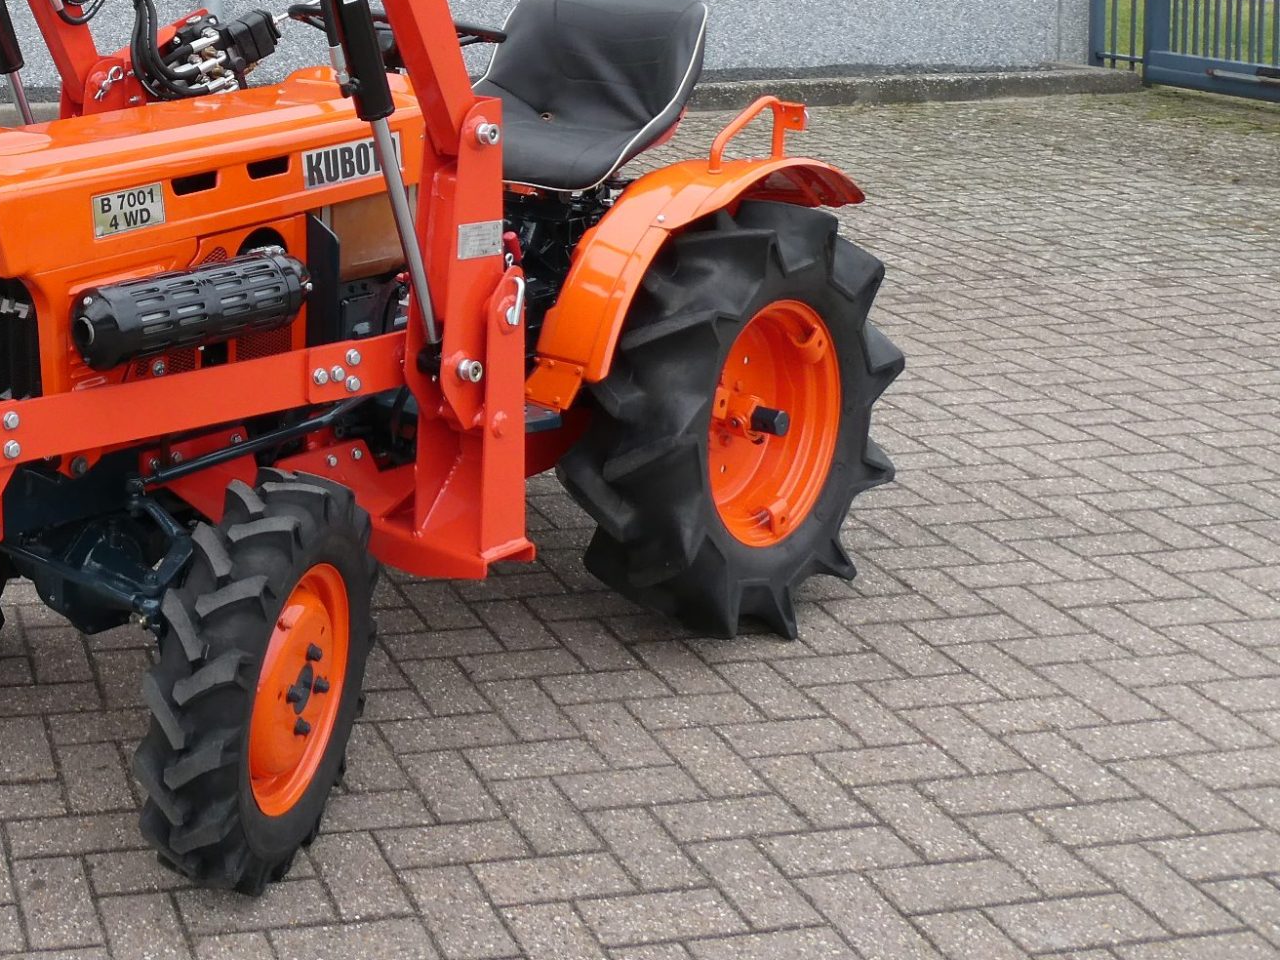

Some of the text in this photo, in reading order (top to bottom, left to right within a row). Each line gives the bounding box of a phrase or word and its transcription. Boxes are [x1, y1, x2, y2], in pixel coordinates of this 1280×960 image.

[306, 137, 397, 186] KUBOT
[101, 188, 154, 213] B 7001
[109, 208, 150, 230] 4 WD
